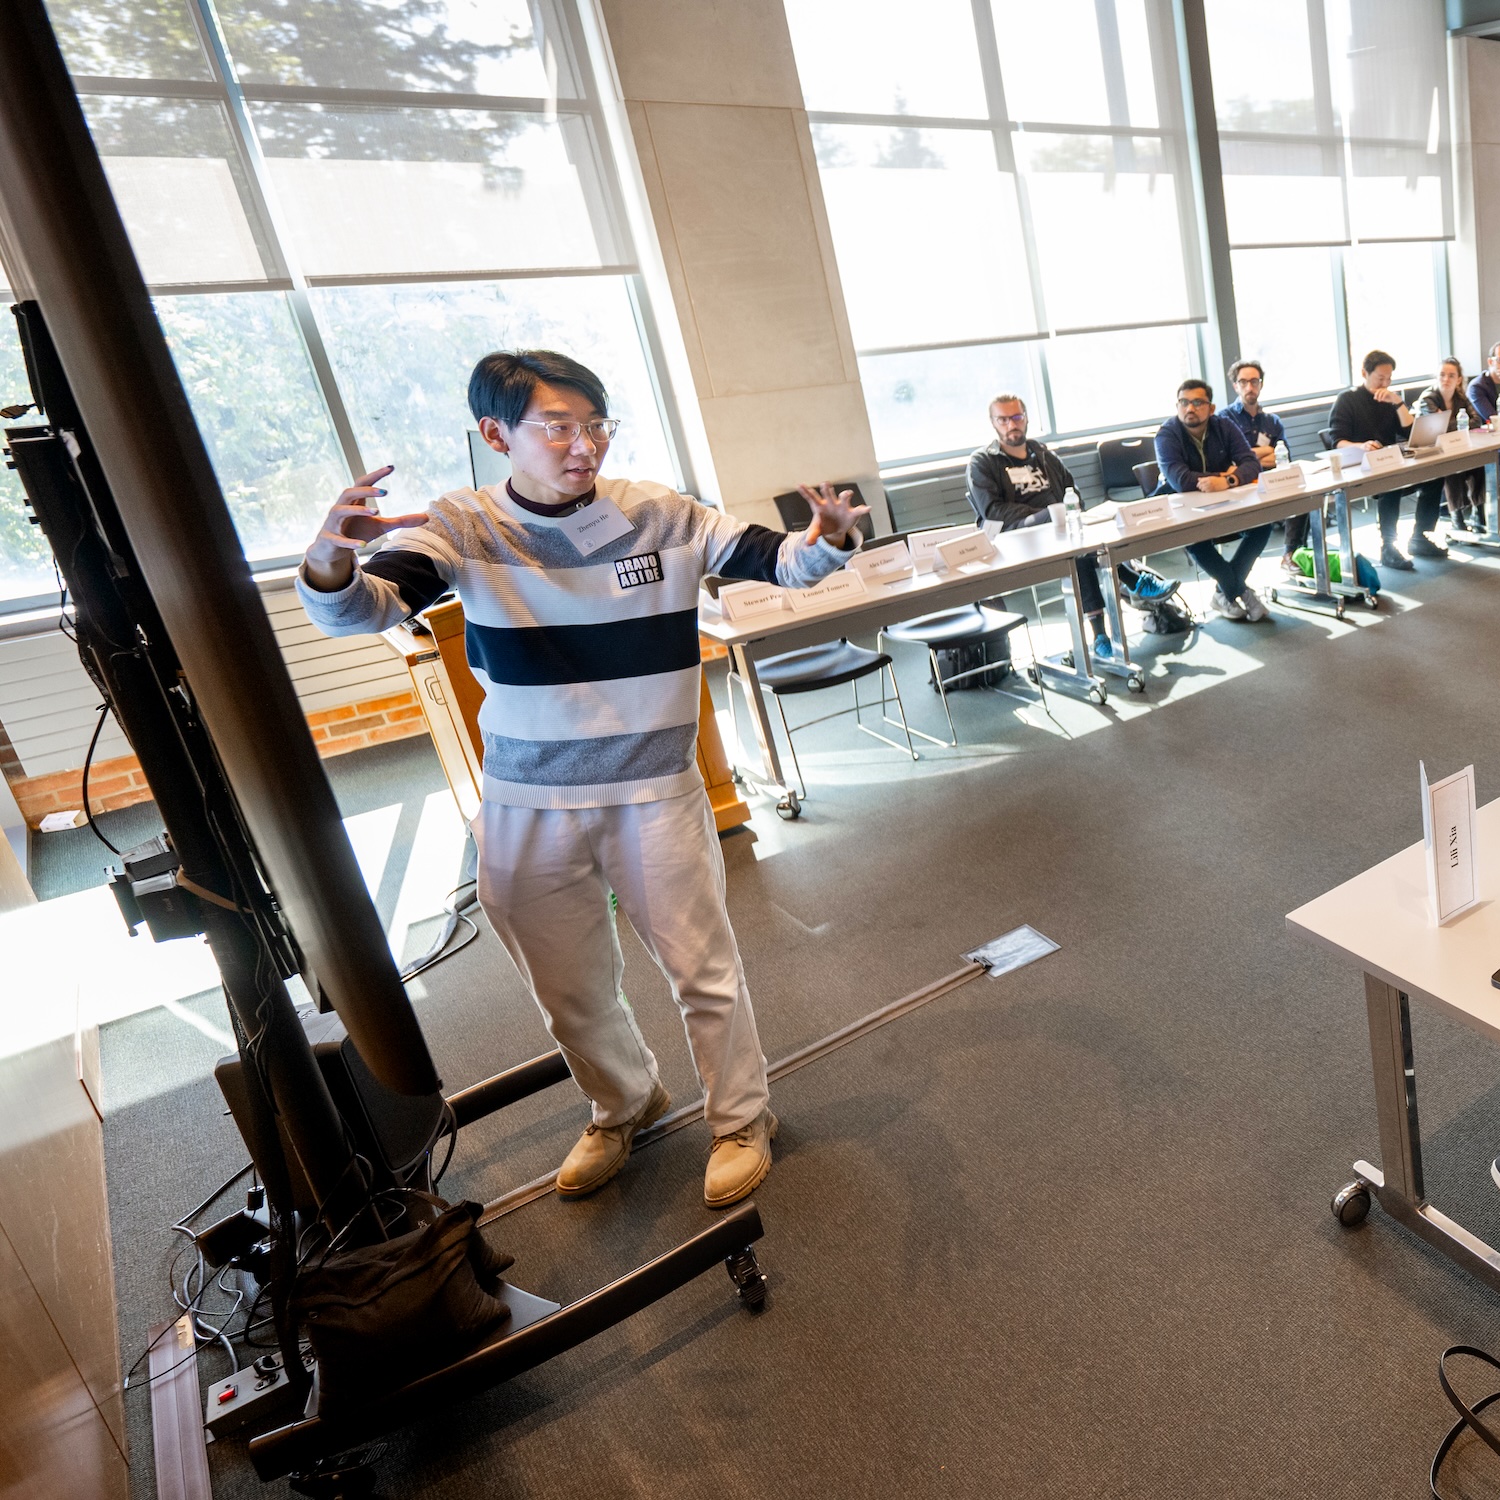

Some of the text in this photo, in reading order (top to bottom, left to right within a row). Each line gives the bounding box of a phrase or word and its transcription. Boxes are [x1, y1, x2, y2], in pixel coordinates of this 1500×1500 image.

[577, 513, 609, 534] Zhenyu He
[615, 554, 658, 575] BRAVO
[619, 568, 660, 588] ABIDE
[743, 595, 770, 607] Stewart
[802, 583, 850, 599] Leonor Tomero
[1449, 825, 1459, 868] Lili Xia
